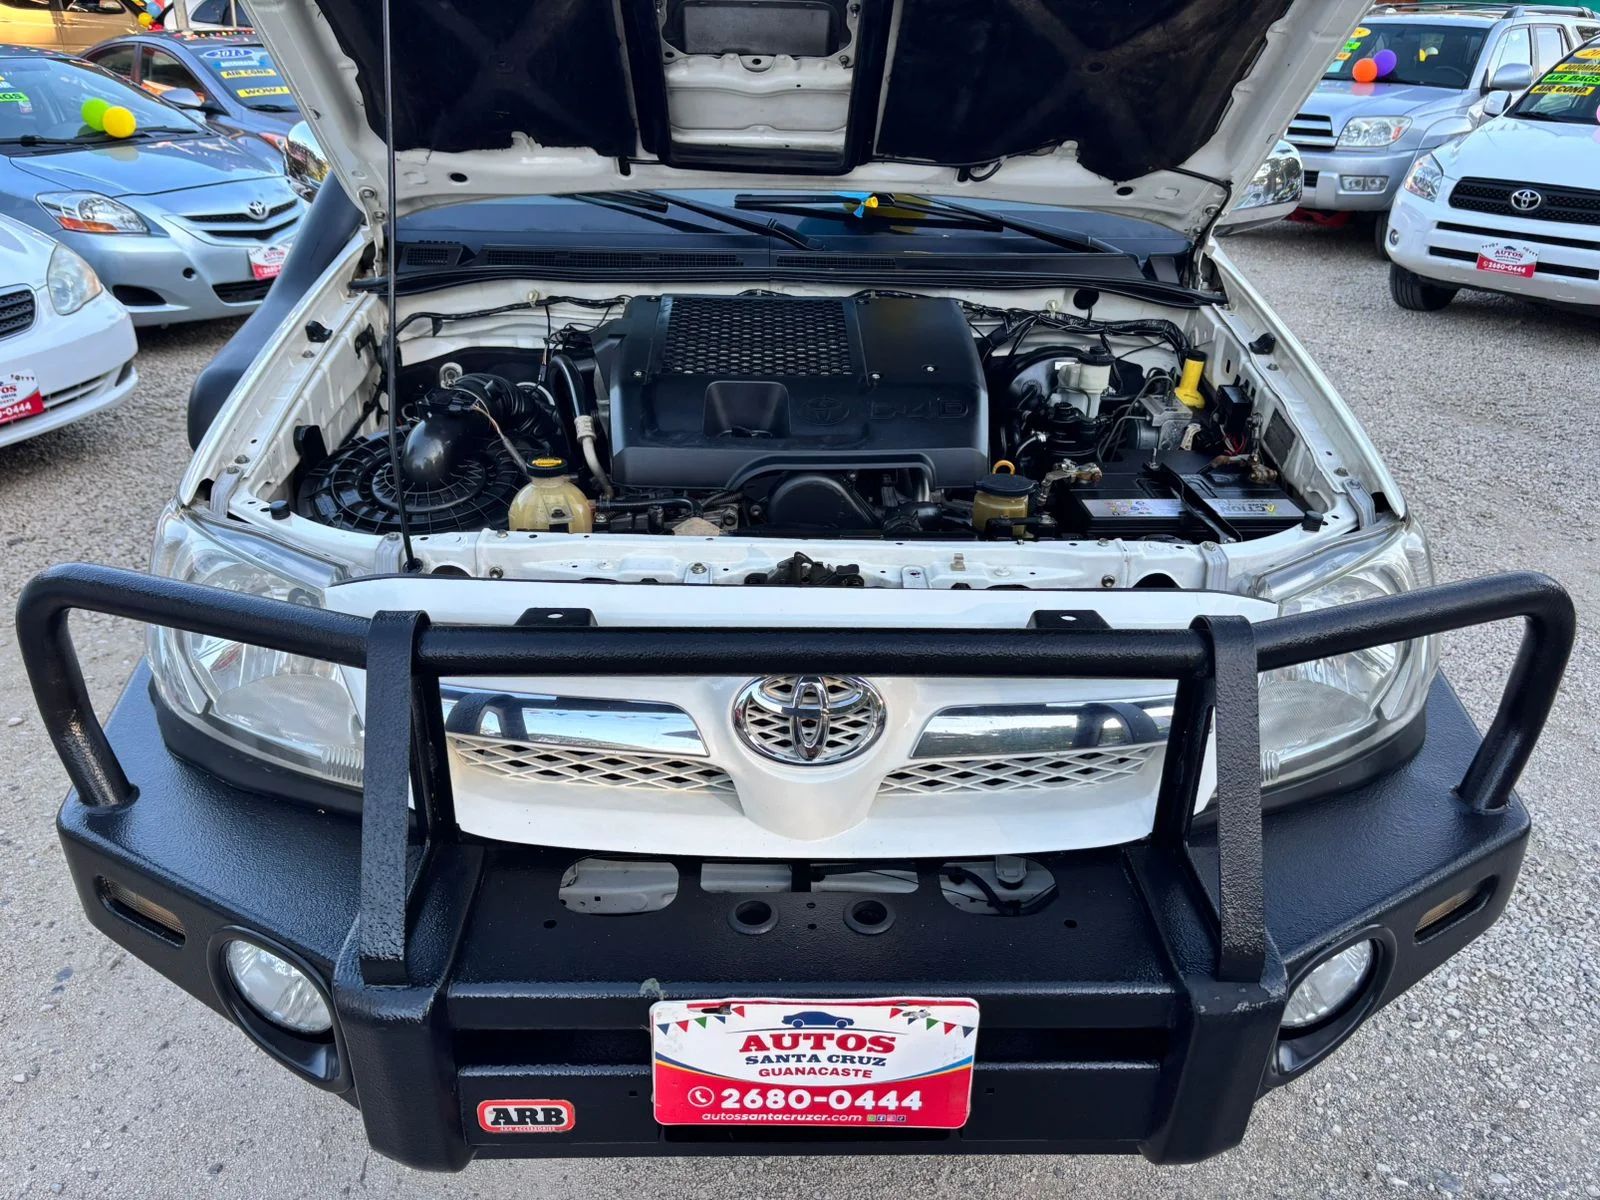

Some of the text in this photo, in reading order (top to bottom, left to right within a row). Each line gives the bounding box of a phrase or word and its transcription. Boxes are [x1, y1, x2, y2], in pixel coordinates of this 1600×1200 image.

[1494, 250, 1523, 259] AUTOS
[738, 1033, 897, 1054] AUTOS
[744, 1053, 887, 1067] SANTA CRUZ
[758, 1066, 873, 1079] GUANACASTE
[720, 1088, 923, 1111] 2680-0444
[490, 1107, 565, 1126] ARB
[701, 1111, 862, 1122] autossantacruzcr.com
